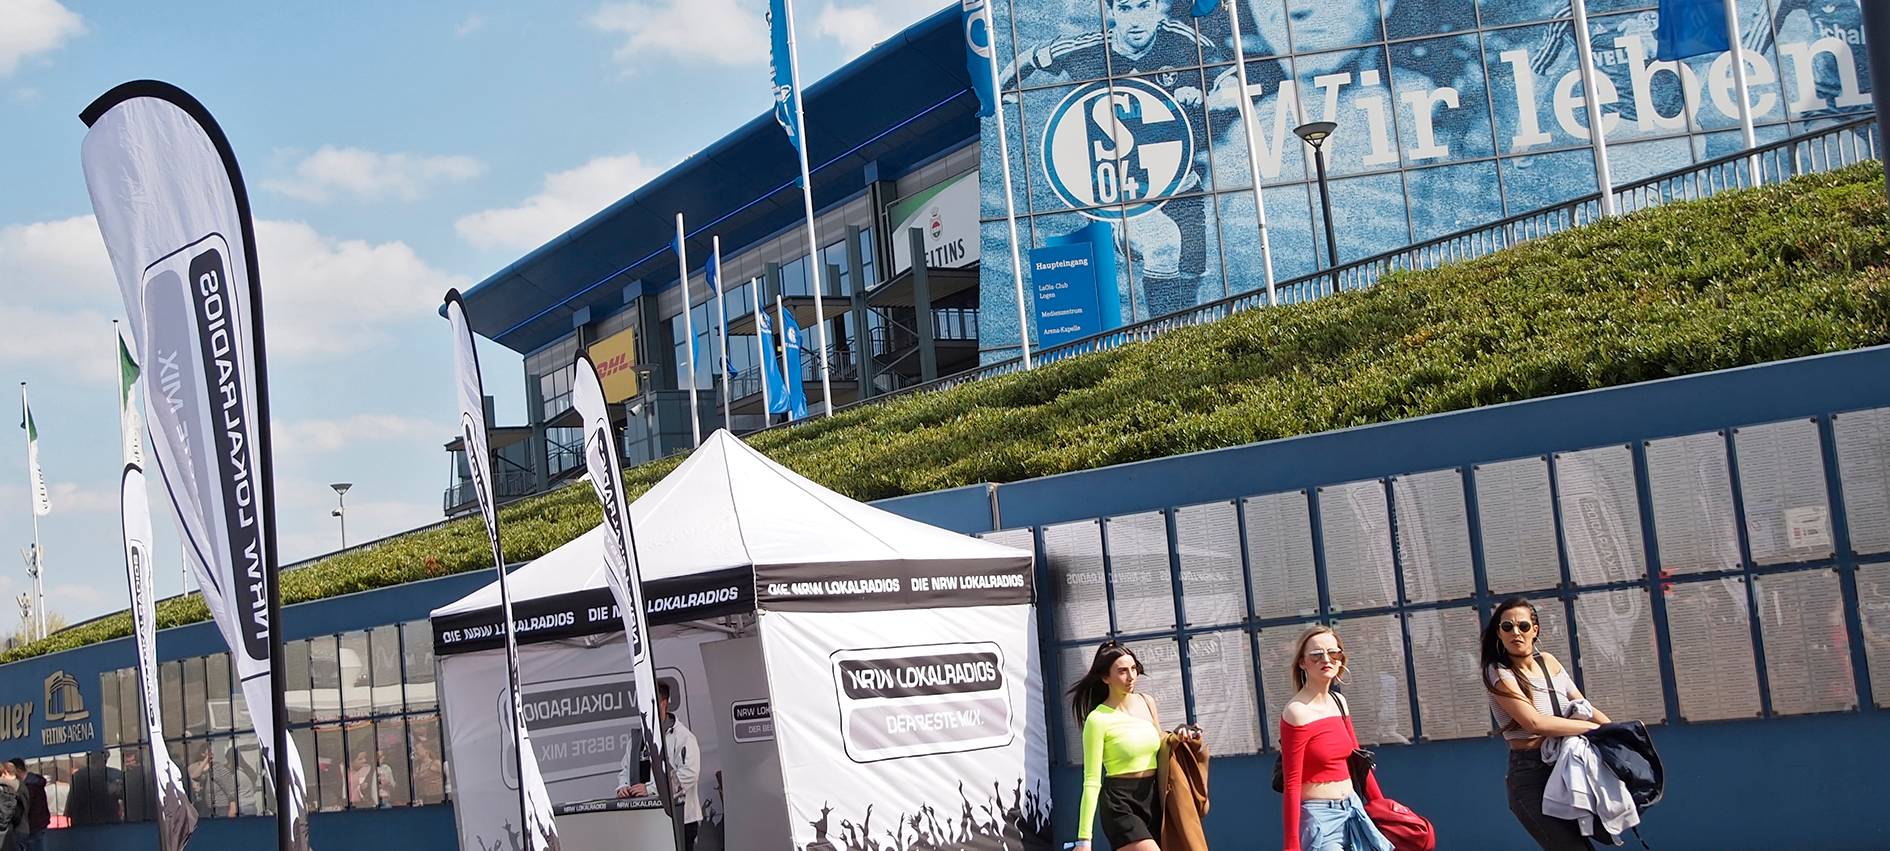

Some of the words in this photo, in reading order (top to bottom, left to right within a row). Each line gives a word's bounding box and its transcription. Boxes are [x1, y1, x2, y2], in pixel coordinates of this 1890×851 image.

[1221, 69, 1460, 178] Wir
[1500, 35, 1872, 148] leben
[1036, 258, 1089, 270] Haupteingang
[597, 352, 629, 378] DHL
[791, 582, 824, 596] NRW
[825, 578, 901, 595] LOKALRADIOS
[910, 577, 930, 592] DIE
[931, 576, 958, 591] NRW
[959, 574, 1025, 590] LOKALRADIOS
[588, 606, 609, 622] DIE
[647, 586, 739, 613] LOKALRADIOS
[443, 630, 462, 644] DIE
[464, 625, 493, 641] NRW
[848, 668, 895, 690] NRW
[896, 661, 996, 688] LOKALRADIOS
[737, 708, 755, 717] NRW
[67, 722, 95, 742] ARENA
